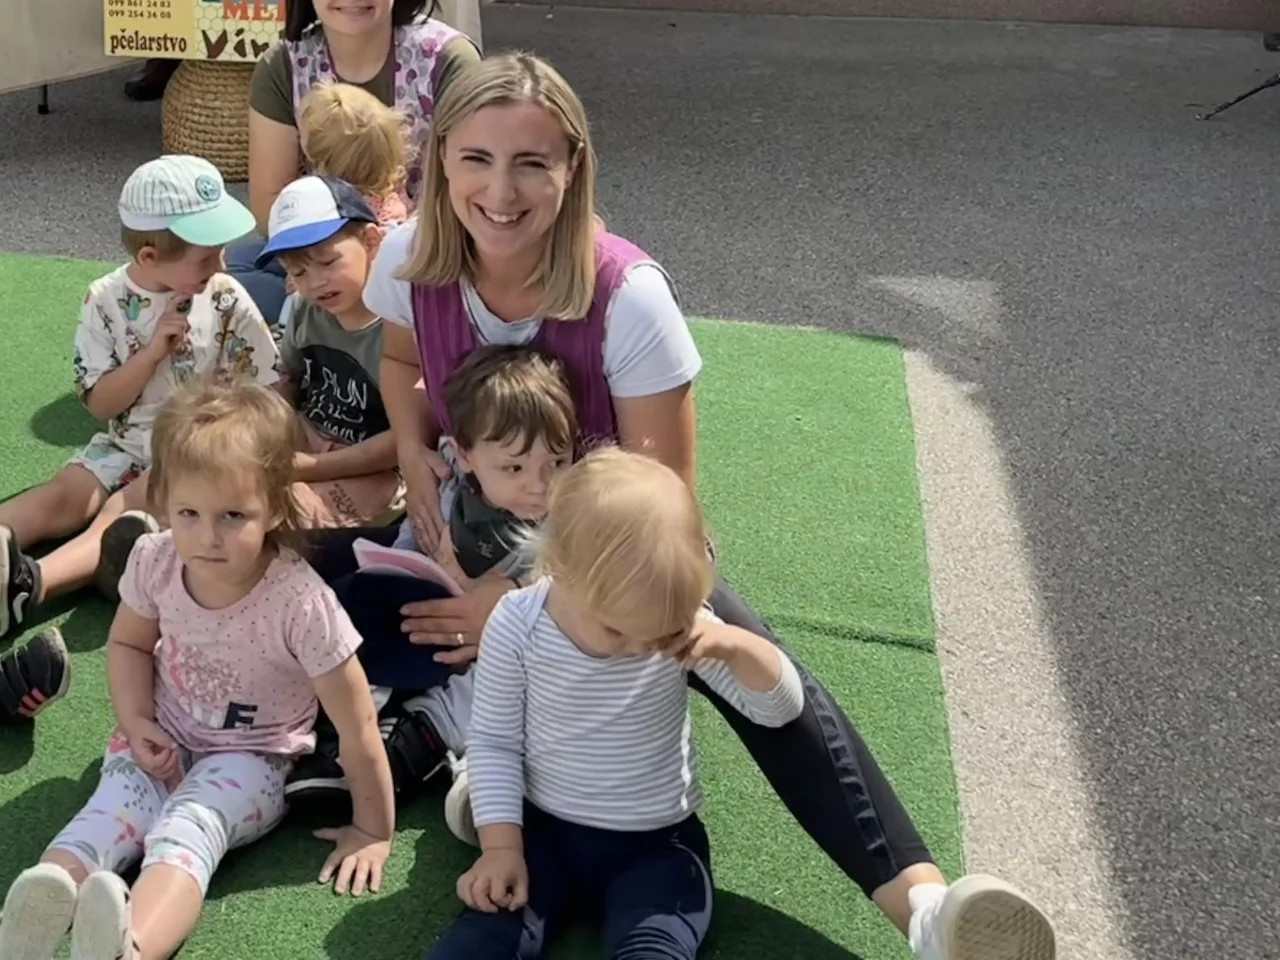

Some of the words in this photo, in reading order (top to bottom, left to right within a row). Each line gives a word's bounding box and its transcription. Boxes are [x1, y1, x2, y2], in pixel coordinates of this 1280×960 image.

[146, 0, 158, 8] 24
[128, 10, 144, 18] 254
[110, 28, 187, 54] pčelarstvo
[320, 366, 367, 410] RUN
